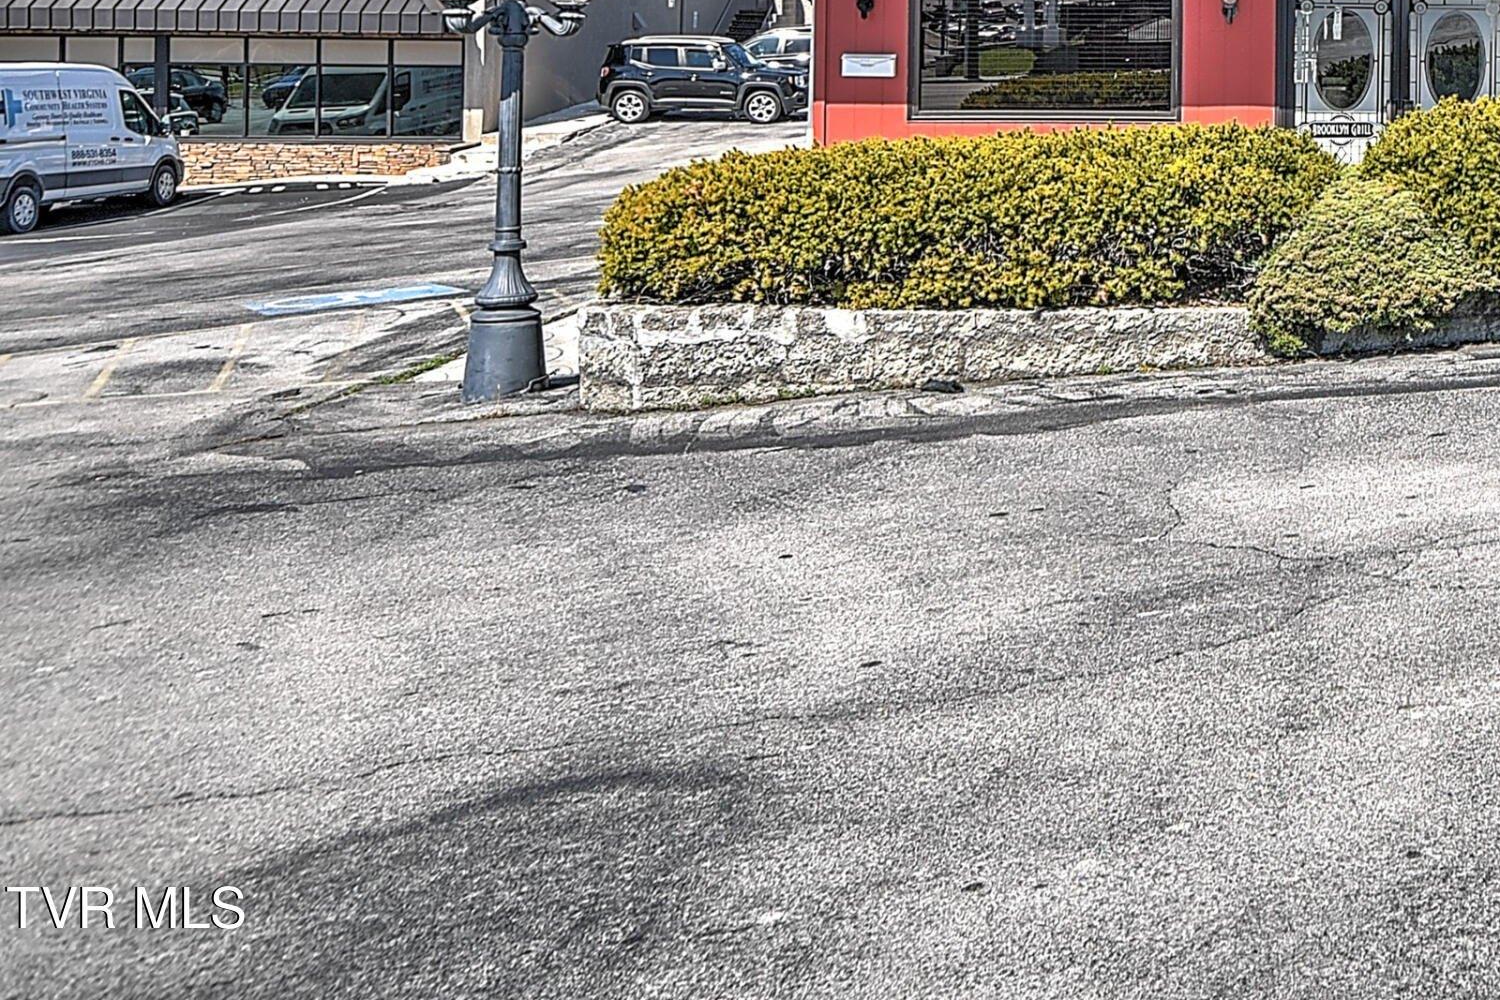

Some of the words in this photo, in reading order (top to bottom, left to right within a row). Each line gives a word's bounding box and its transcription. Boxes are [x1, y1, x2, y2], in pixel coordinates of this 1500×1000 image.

[22, 89, 71, 100] SOUTHWEST
[73, 88, 107, 99] VIRGINIA
[1313, 124, 1350, 136] BROOKLYN
[1350, 123, 1372, 136] GRILL
